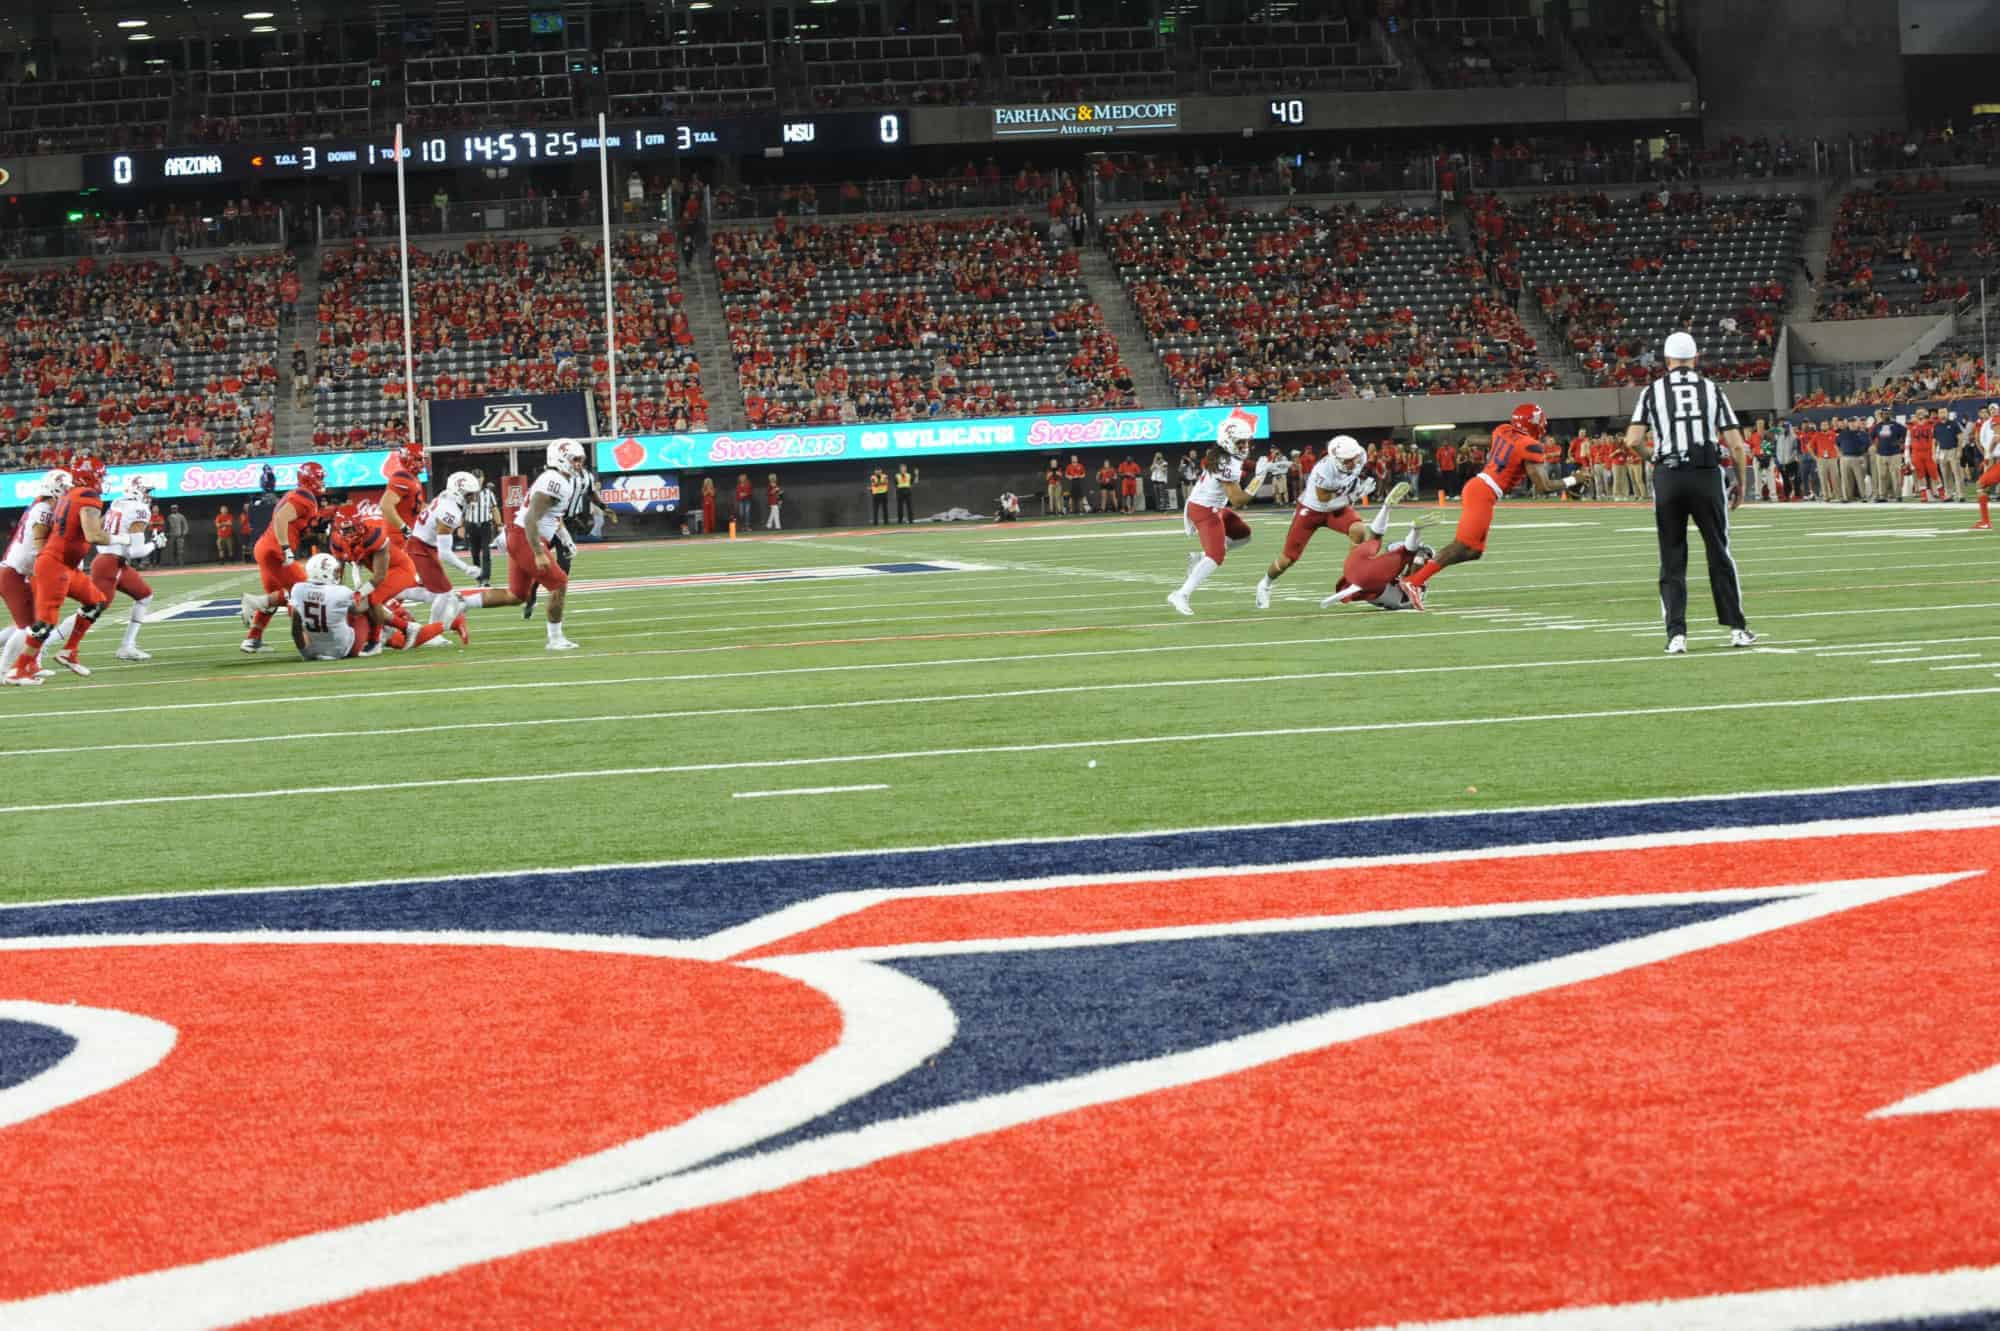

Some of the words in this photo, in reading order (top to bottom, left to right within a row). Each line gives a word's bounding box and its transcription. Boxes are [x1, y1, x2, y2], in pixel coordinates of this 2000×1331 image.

[995, 107, 1076, 124] FARHANG
[1077, 105, 1093, 121] &
[1094, 103, 1177, 120] MEDCOFF
[1271, 100, 1304, 123] 40
[1060, 124, 1114, 136] Attorneys
[113, 156, 132, 184] 0
[164, 155, 222, 176] ARIZONA
[302, 147, 316, 169] 3
[327, 151, 357, 162] DOWN
[369, 144, 375, 164] 1
[380, 148, 394, 159] TO
[422, 139, 446, 162] 10
[464, 132, 537, 161] 14:57
[545, 132, 578, 156] 25
[635, 130, 642, 150] 1
[677, 126, 691, 149] 3
[783, 123, 815, 142] WSU
[880, 115, 899, 143] 0
[1671, 384, 1702, 418] R
[861, 431, 889, 449] GO
[303, 601, 329, 633] 51
